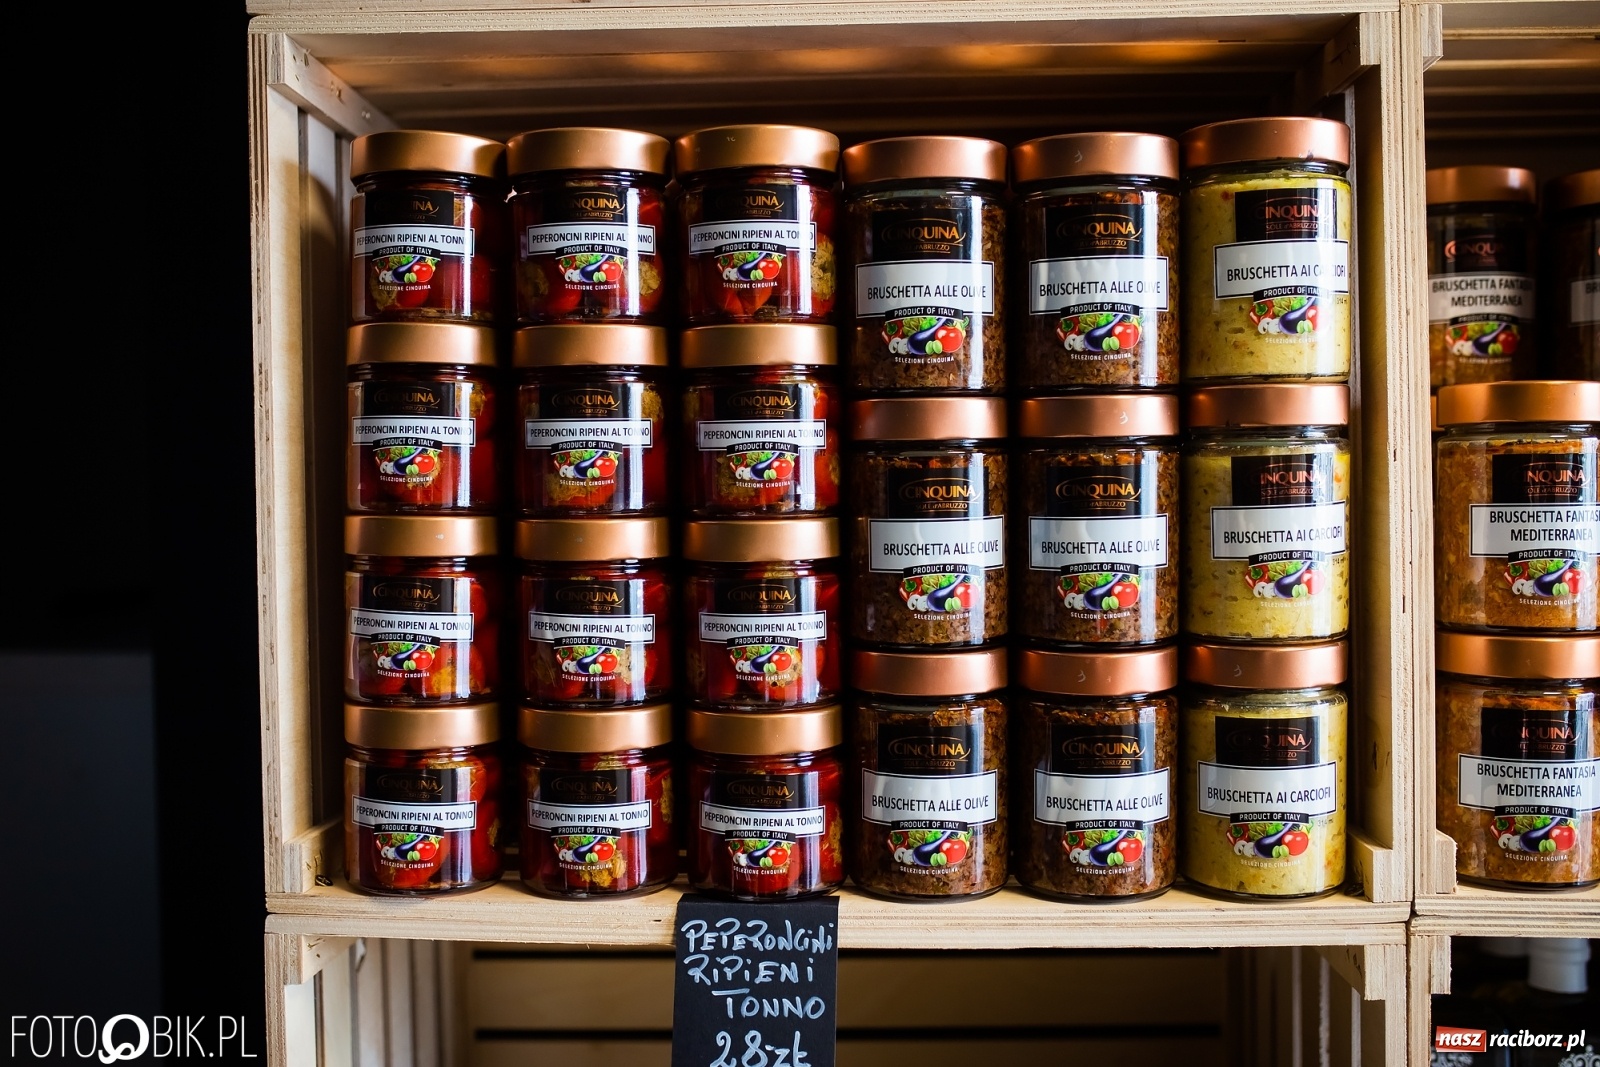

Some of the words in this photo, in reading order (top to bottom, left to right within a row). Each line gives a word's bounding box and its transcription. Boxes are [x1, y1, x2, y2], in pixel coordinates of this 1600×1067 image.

[398, 234, 426, 242] RIPIENI
[429, 235, 438, 243] AL
[441, 234, 464, 245] TONN
[533, 232, 582, 243] PEPERONCINI
[585, 232, 614, 241] RIPIENI
[617, 233, 625, 241] AL
[694, 230, 740, 242] PEPERONCINI
[742, 230, 772, 238] RIPIENI
[564, 245, 591, 254] PRODUCT
[1227, 265, 1298, 281] BRUSCHETTA
[1301, 265, 1310, 276] AI
[1040, 281, 1107, 296] BRUSCHETTA
[1110, 281, 1133, 293] ALLE
[1264, 287, 1294, 297] PRODUCT
[1433, 278, 1496, 293] BRUSCHETTA
[868, 285, 931, 300] BRUSCHETTA
[935, 285, 958, 297] ALLE
[961, 286, 986, 298] OLIVE
[894, 307, 924, 317] PRODUCT
[938, 307, 954, 316] ITALY
[1070, 304, 1100, 313] PRODUCT
[1115, 304, 1131, 312] ITALY
[356, 426, 397, 434] PEPERONCINI
[399, 426, 428, 434] RIPIENI
[531, 428, 577, 437] PEPERONCINI
[580, 428, 609, 436] RIPIENI
[612, 428, 621, 436] AL
[704, 430, 753, 439] PEPERONCINI
[756, 430, 785, 438] RIPIENI
[1063, 483, 1135, 498] CINQUINA
[1490, 511, 1563, 523] BRUSCHETTA
[1224, 530, 1293, 543] BRUSCHETTA
[1296, 531, 1305, 542] AI
[1511, 529, 1592, 541] MEDITERRANEA
[884, 543, 950, 555] BRUSCHETTA
[954, 542, 974, 554] ALLE
[978, 540, 999, 553] OLIVE
[1042, 541, 1106, 554] BRUSCHETTA
[1110, 541, 1132, 553] ALLE
[1136, 539, 1160, 552] OLIVE
[1259, 552, 1290, 561] PRODUCT
[1519, 550, 1551, 558] PRODUCT
[913, 565, 943, 574] PRODUCT
[354, 616, 395, 628] PEPERONCINI
[398, 621, 426, 630] RIPIENI
[429, 622, 439, 630] AL
[442, 622, 470, 631] TONNO
[534, 621, 580, 632] PEPERONCINI
[583, 624, 612, 632] RIPIENI
[626, 624, 652, 632] TONNO
[705, 622, 752, 632] PEPERONCINI
[755, 624, 784, 632] RIPIENI
[787, 623, 796, 631] AL
[798, 621, 823, 631] TONNO
[894, 743, 965, 756] CINQUINA
[1068, 742, 1140, 757] CINQUINA
[1478, 763, 1550, 779] BRUSCHETTA
[1553, 766, 1595, 779] FANTASIA
[1208, 787, 1273, 804] BRUSCHETTA
[1276, 792, 1286, 804] AI
[1290, 787, 1330, 803] CARCIOFI
[1498, 784, 1581, 797] MEDITERRANEA
[872, 795, 935, 811] BRUSCHETTA
[939, 798, 961, 811] ALLE
[964, 795, 988, 810] OLIVE
[1047, 796, 1113, 811] BRUSCHETTA
[1116, 798, 1138, 811] ALLE
[1141, 793, 1162, 809] OLIVE
[357, 806, 399, 819] PEPERONCINI
[402, 812, 430, 821] RIPIENI
[446, 811, 472, 820] TONNO
[532, 809, 575, 822] PEPERONCINI
[578, 814, 606, 822] RIPIENI
[609, 813, 619, 821] AL
[621, 810, 648, 820] TONNO
[705, 812, 751, 826] PEPERONCINI
[754, 818, 782, 826] RIPIENI
[785, 818, 794, 826] AL
[796, 816, 822, 826] TONNO
[712, 988, 825, 1019] TONNO
